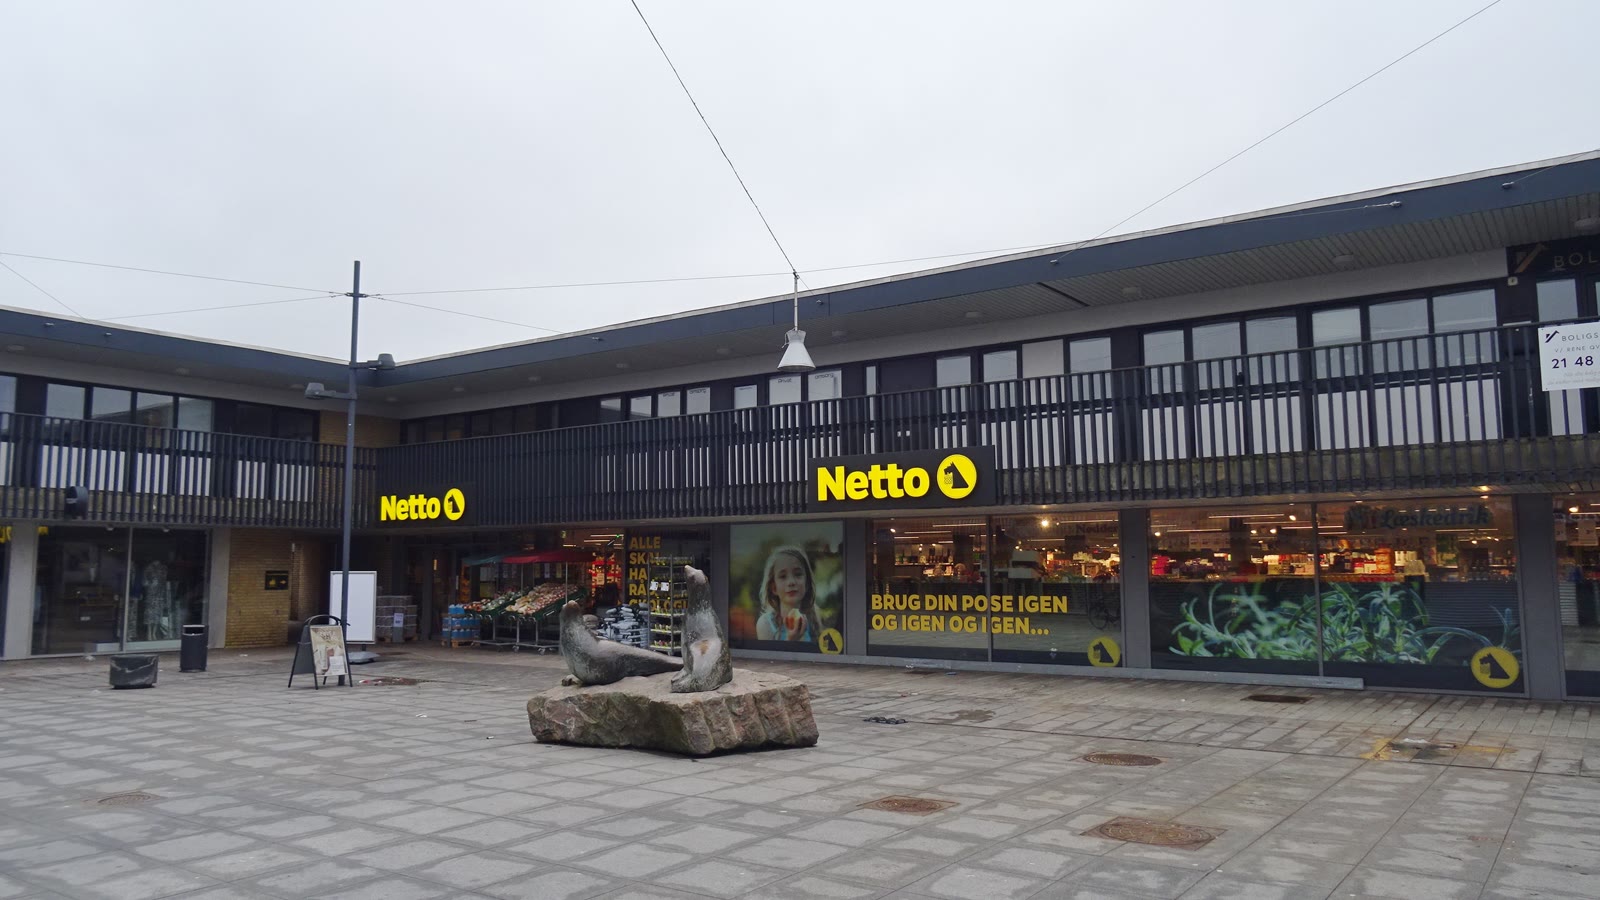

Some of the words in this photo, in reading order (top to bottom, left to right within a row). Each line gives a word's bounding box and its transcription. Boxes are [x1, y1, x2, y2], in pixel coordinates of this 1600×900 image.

[1561, 332, 1599, 341] BOLIGS
[1551, 357, 1567, 369] 21
[1574, 355, 1594, 367] 48
[817, 463, 930, 501] Netto
[381, 494, 441, 520] Netto
[630, 536, 661, 549] ALLE
[871, 594, 921, 611] BRUG
[924, 594, 957, 611] DIN
[961, 595, 1014, 613] POSE
[1018, 595, 1068, 613] IGEN
[871, 614, 898, 631] OG
[901, 614, 945, 632] IGEN
[949, 615, 977, 633] OG
